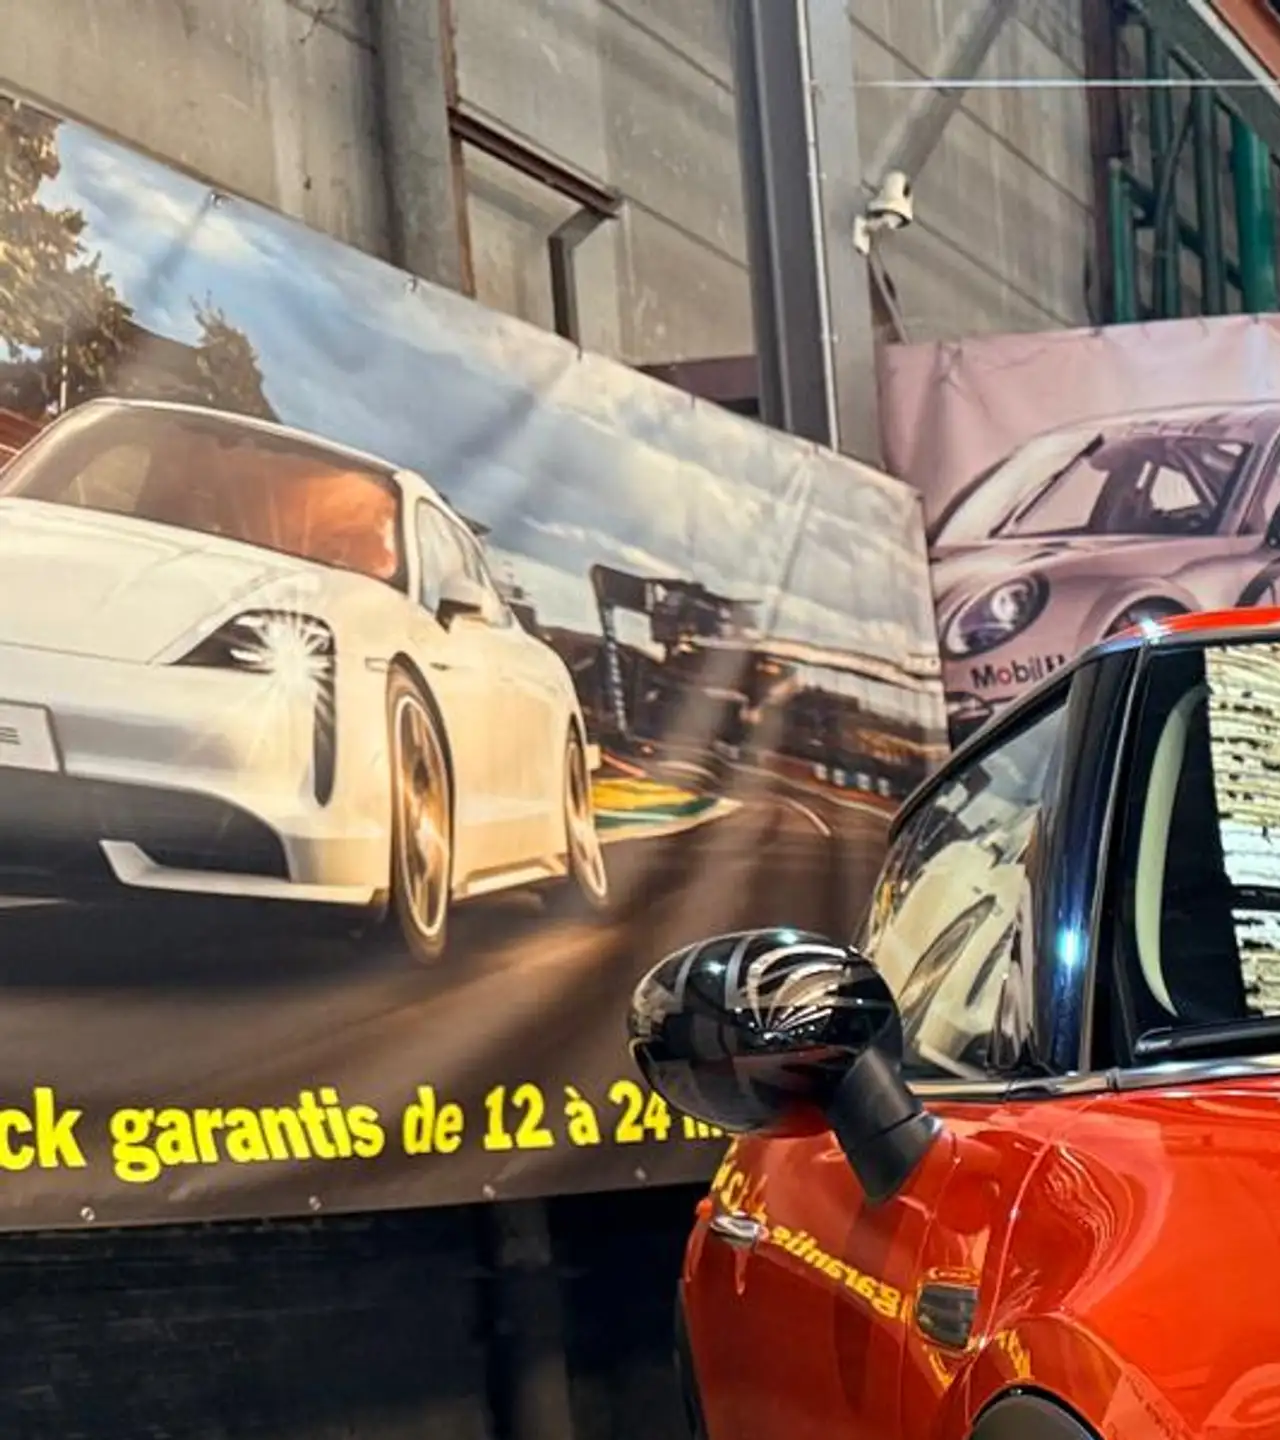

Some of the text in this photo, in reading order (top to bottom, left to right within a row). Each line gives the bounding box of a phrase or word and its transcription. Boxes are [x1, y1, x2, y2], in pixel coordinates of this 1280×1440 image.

[110, 1087, 384, 1183] garantis
[403, 1085, 464, 1156] de
[484, 1082, 553, 1151] 12
[563, 1085, 601, 1147] à
[609, 1079, 671, 1143] 24
